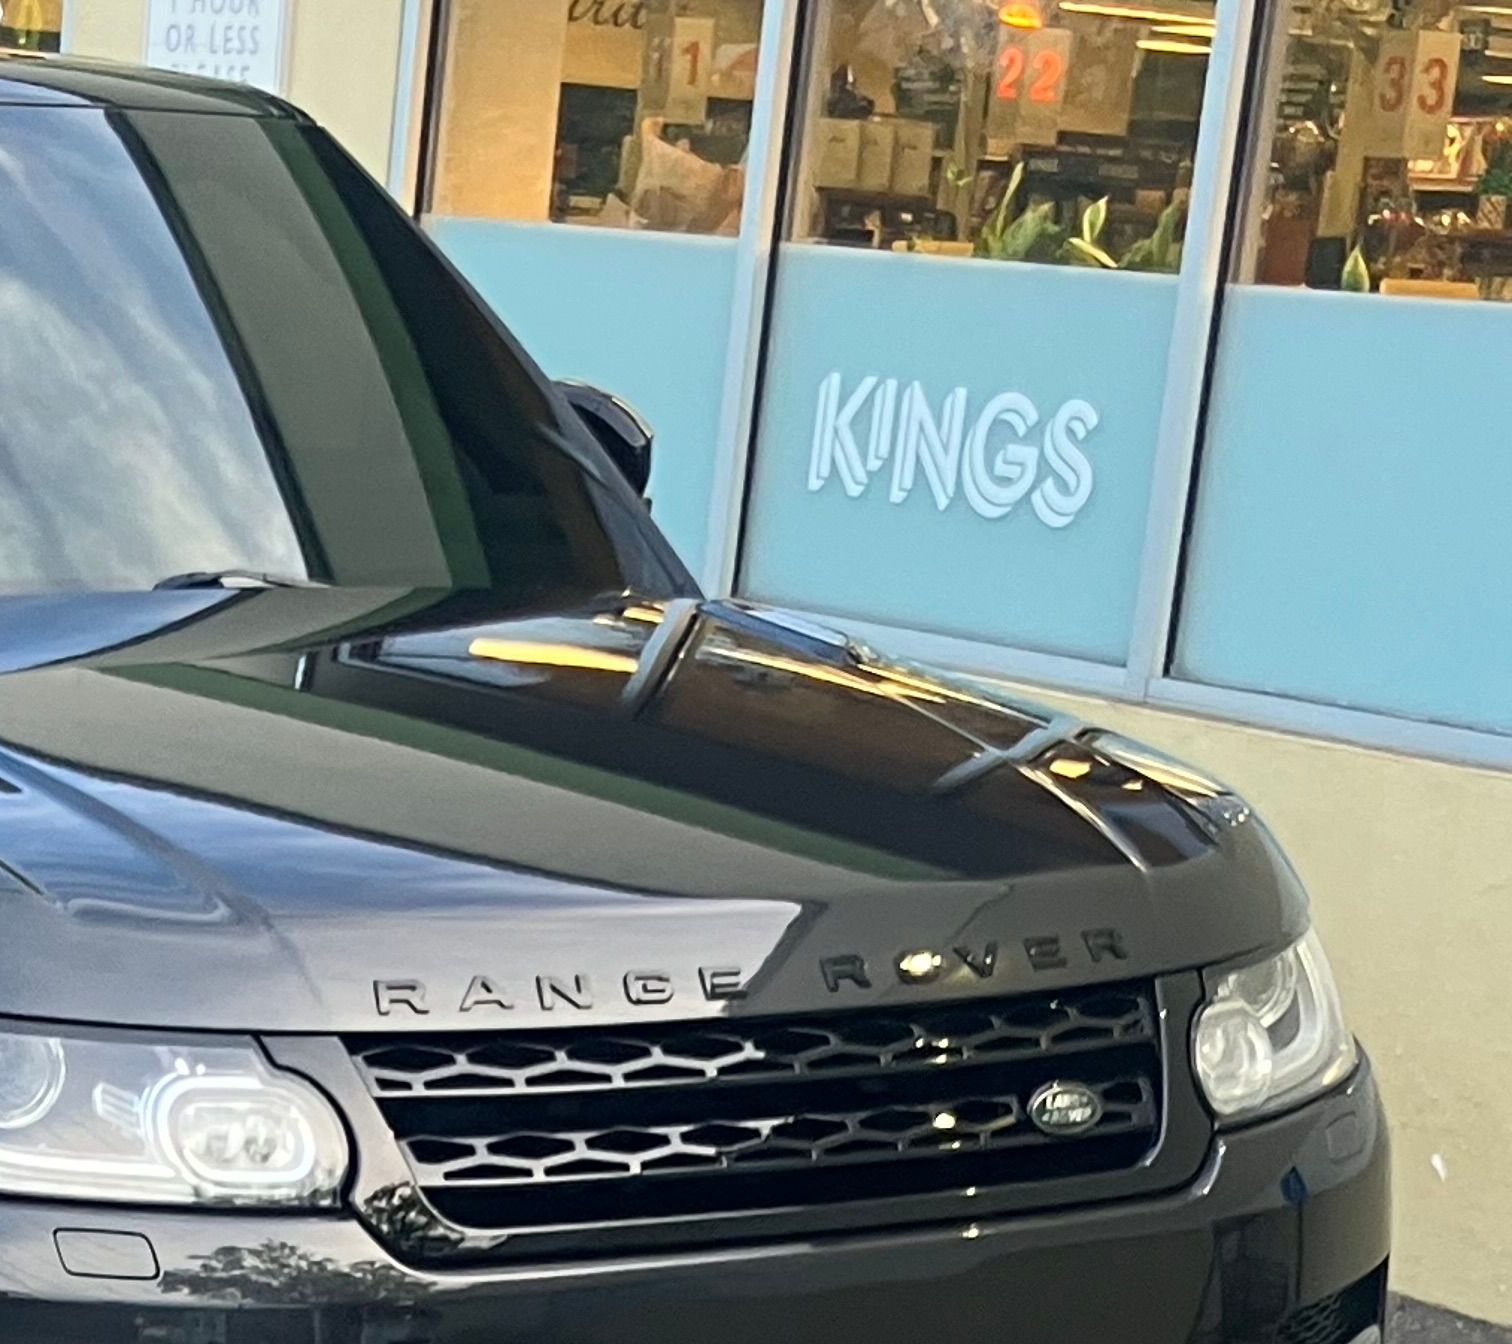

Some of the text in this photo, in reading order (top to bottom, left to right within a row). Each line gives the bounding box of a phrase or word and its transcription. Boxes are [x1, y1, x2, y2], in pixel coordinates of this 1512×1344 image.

[165, 23, 260, 55] OR LESS
[807, 371, 1099, 528] KINGS
[372, 927, 1128, 1016] RANGE ROVER
